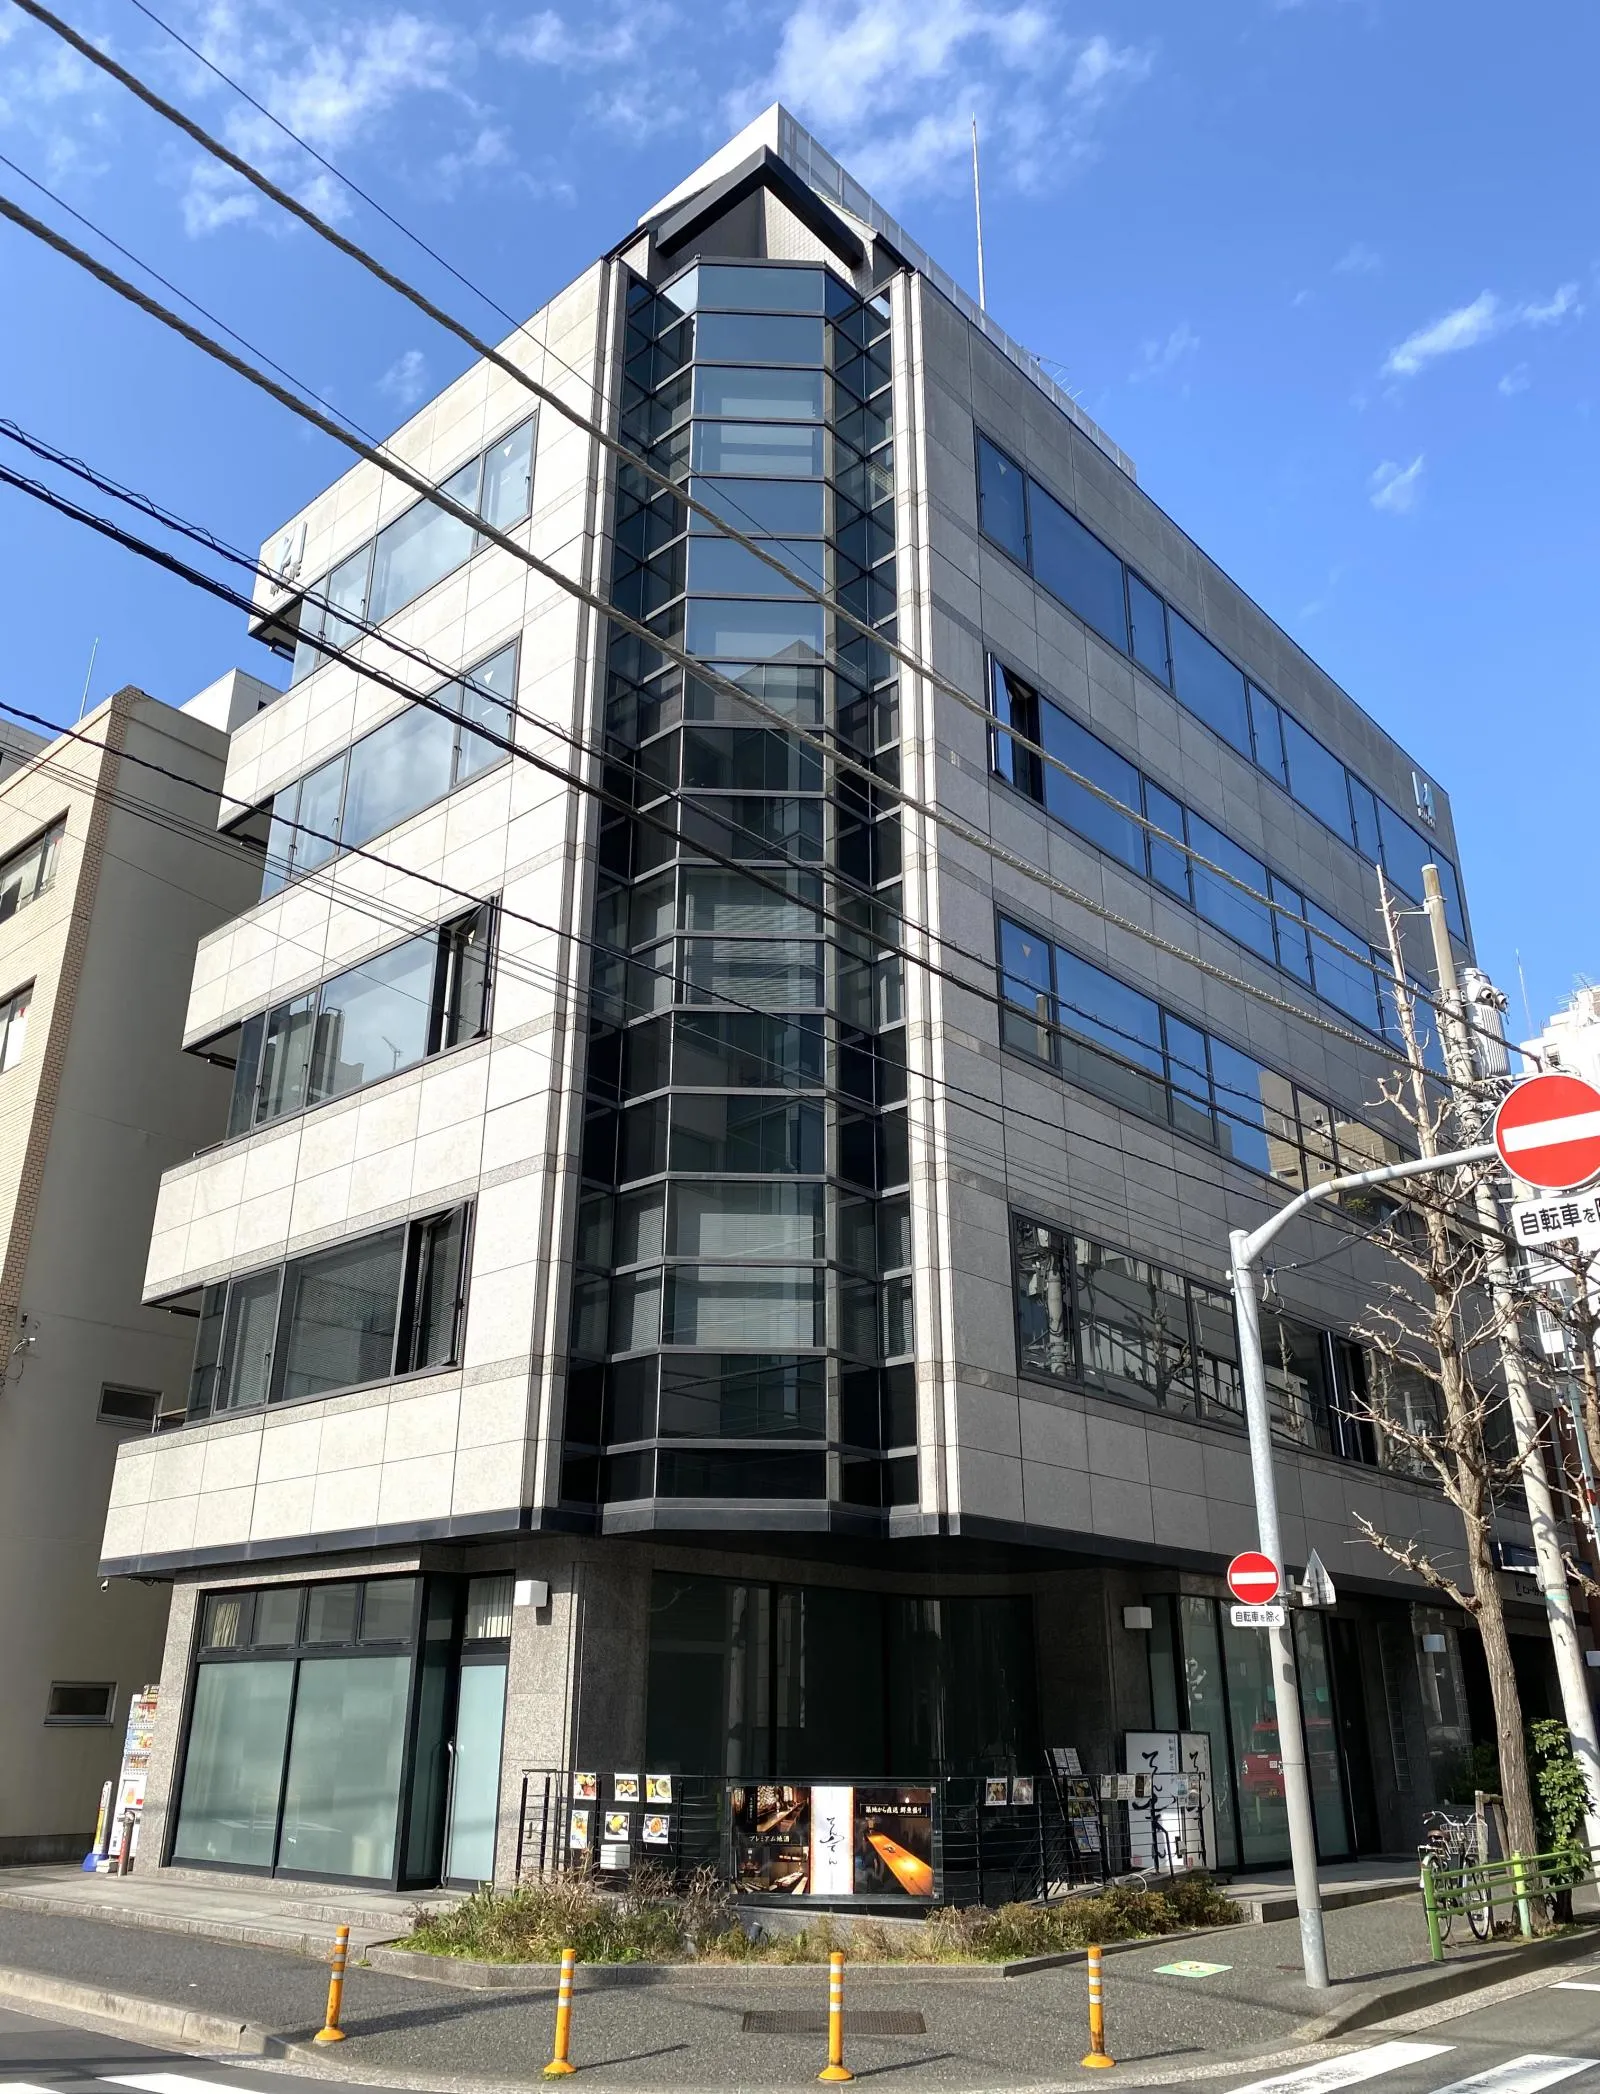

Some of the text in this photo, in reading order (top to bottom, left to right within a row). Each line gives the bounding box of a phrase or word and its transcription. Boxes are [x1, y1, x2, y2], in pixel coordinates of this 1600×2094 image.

[1520, 1199, 1600, 1235] 自転車を
[1236, 1611, 1280, 1622] 自転車を除く
